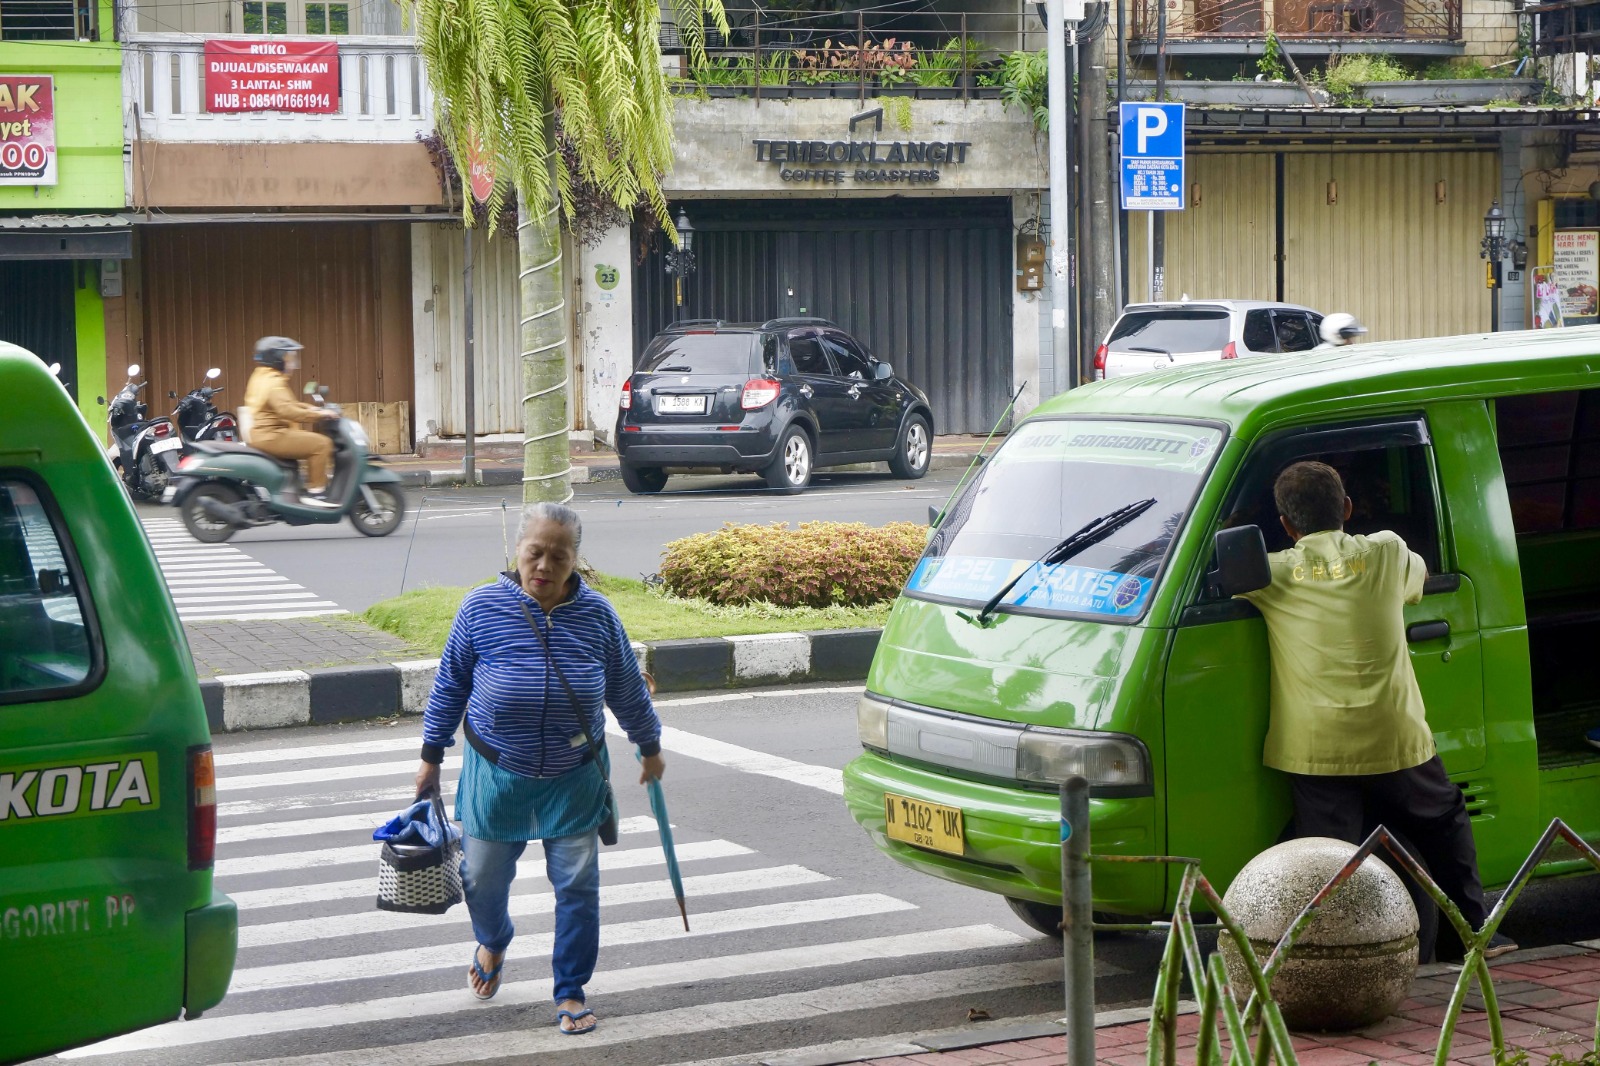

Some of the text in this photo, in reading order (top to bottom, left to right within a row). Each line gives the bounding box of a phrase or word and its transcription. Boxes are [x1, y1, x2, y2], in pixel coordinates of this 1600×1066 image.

[250, 44, 287, 54] RUKO
[231, 80, 237, 89] 3
[287, 80, 312, 90] SHM
[214, 94, 240, 108] HUB
[250, 94, 330, 108] 085101661914
[1138, 107, 1168, 153] P
[0, 142, 46, 169] 00
[752, 140, 972, 163] TEMBOKLANGIT
[780, 169, 940, 182] COFFEE ROASTERS
[602, 274, 615, 283] 23
[1067, 435, 1188, 454] SONGGORITI
[1293, 559, 1366, 581] CREW
[1081, 597, 1105, 609] BATU
[0, 759, 152, 820] KOTA
[887, 798, 961, 838] N 1162 UK
[0, 894, 135, 938] GORITI PP
